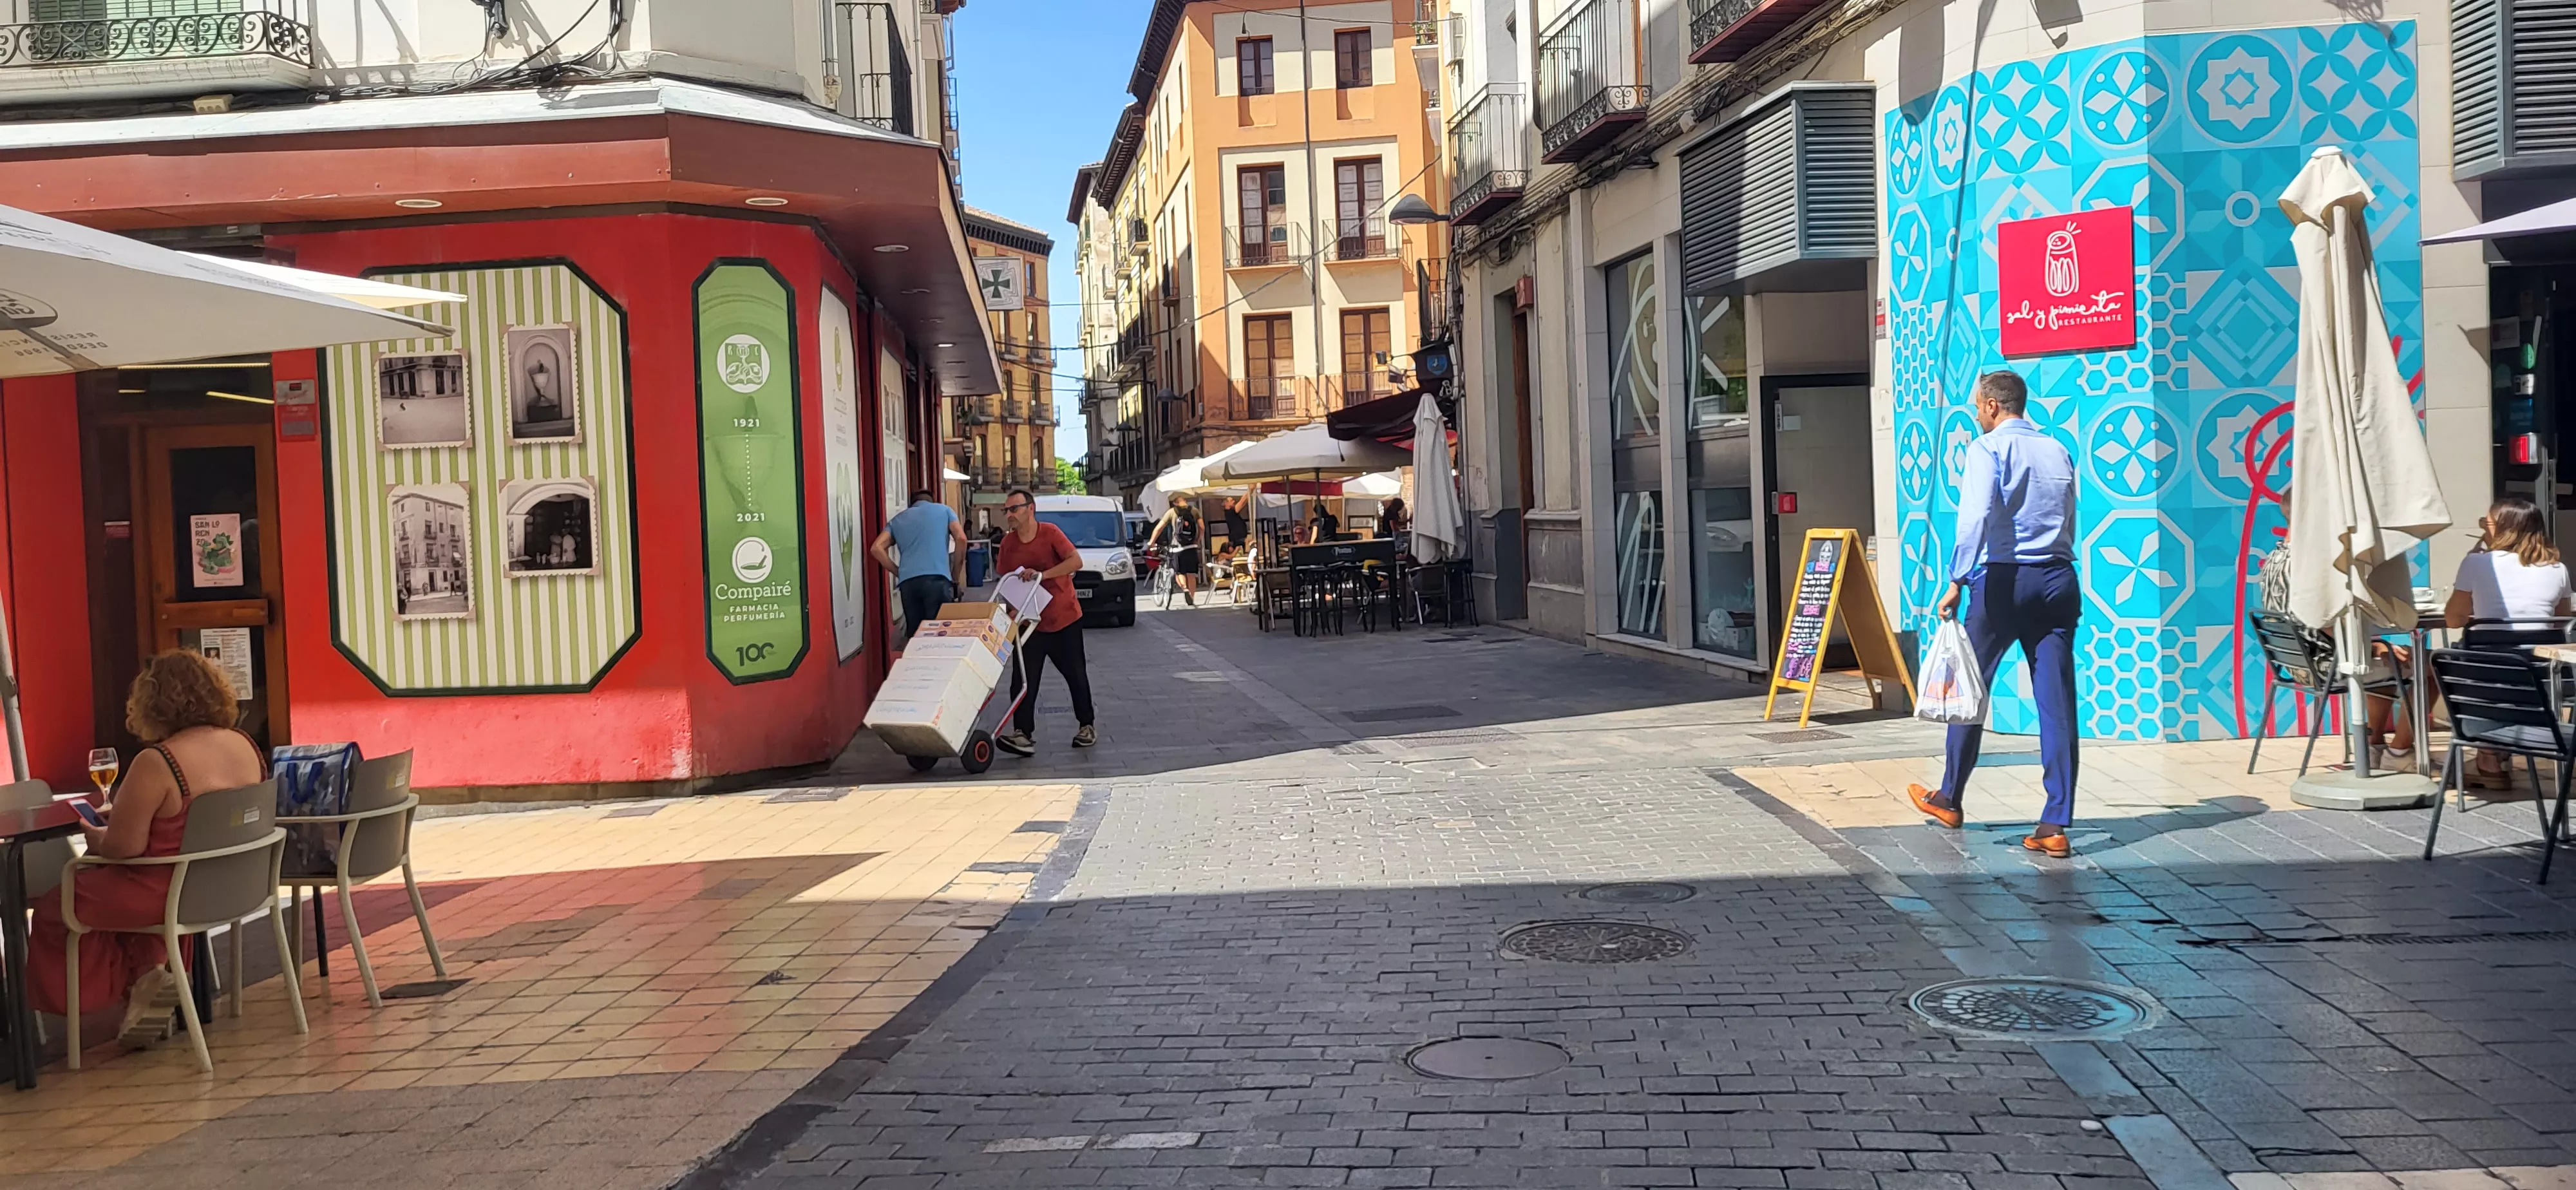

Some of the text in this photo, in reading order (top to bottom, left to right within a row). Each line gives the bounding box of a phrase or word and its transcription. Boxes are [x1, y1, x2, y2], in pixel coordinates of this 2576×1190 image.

[2034, 309, 2045, 329] y
[2049, 290, 2125, 330] pimienta
[2058, 314, 2123, 326] RESTAURANTE
[733, 418, 760, 427] 1921
[736, 513, 765, 522] 2021
[715, 581, 791, 601] Compairé
[730, 603, 779, 613] FARMACIA
